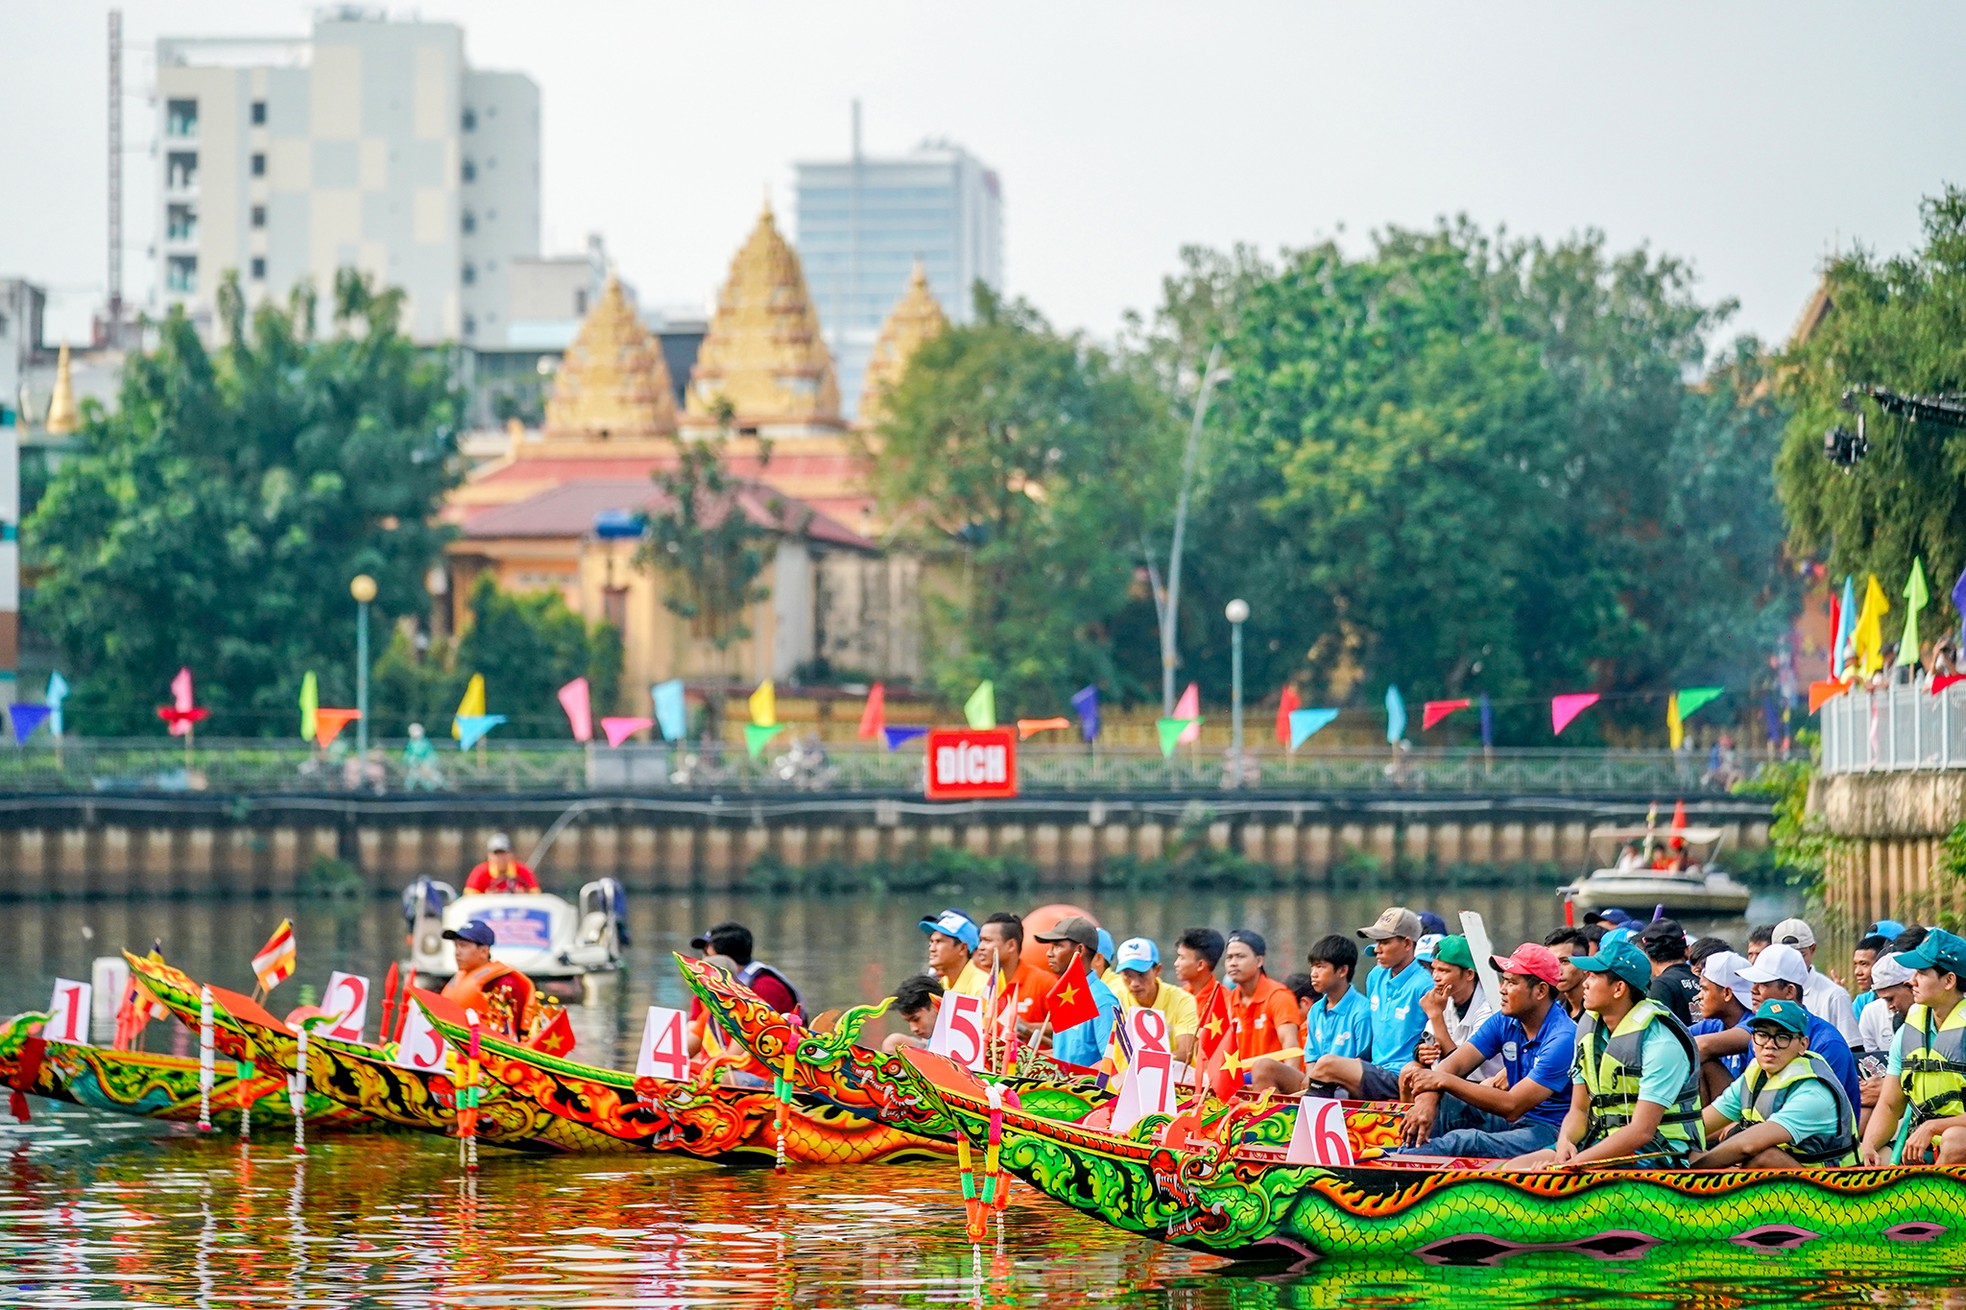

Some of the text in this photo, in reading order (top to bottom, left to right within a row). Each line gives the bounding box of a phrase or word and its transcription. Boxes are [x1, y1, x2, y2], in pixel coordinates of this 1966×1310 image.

[936, 739, 1007, 784] ĐÍCH
[58, 985, 82, 1042] 1
[330, 975, 365, 1041] 2
[950, 995, 980, 1067] 5
[1134, 1009, 1167, 1053] 8
[653, 1011, 687, 1079] 4
[1137, 1049, 1171, 1112] 7
[1315, 1101, 1351, 1166] 6
